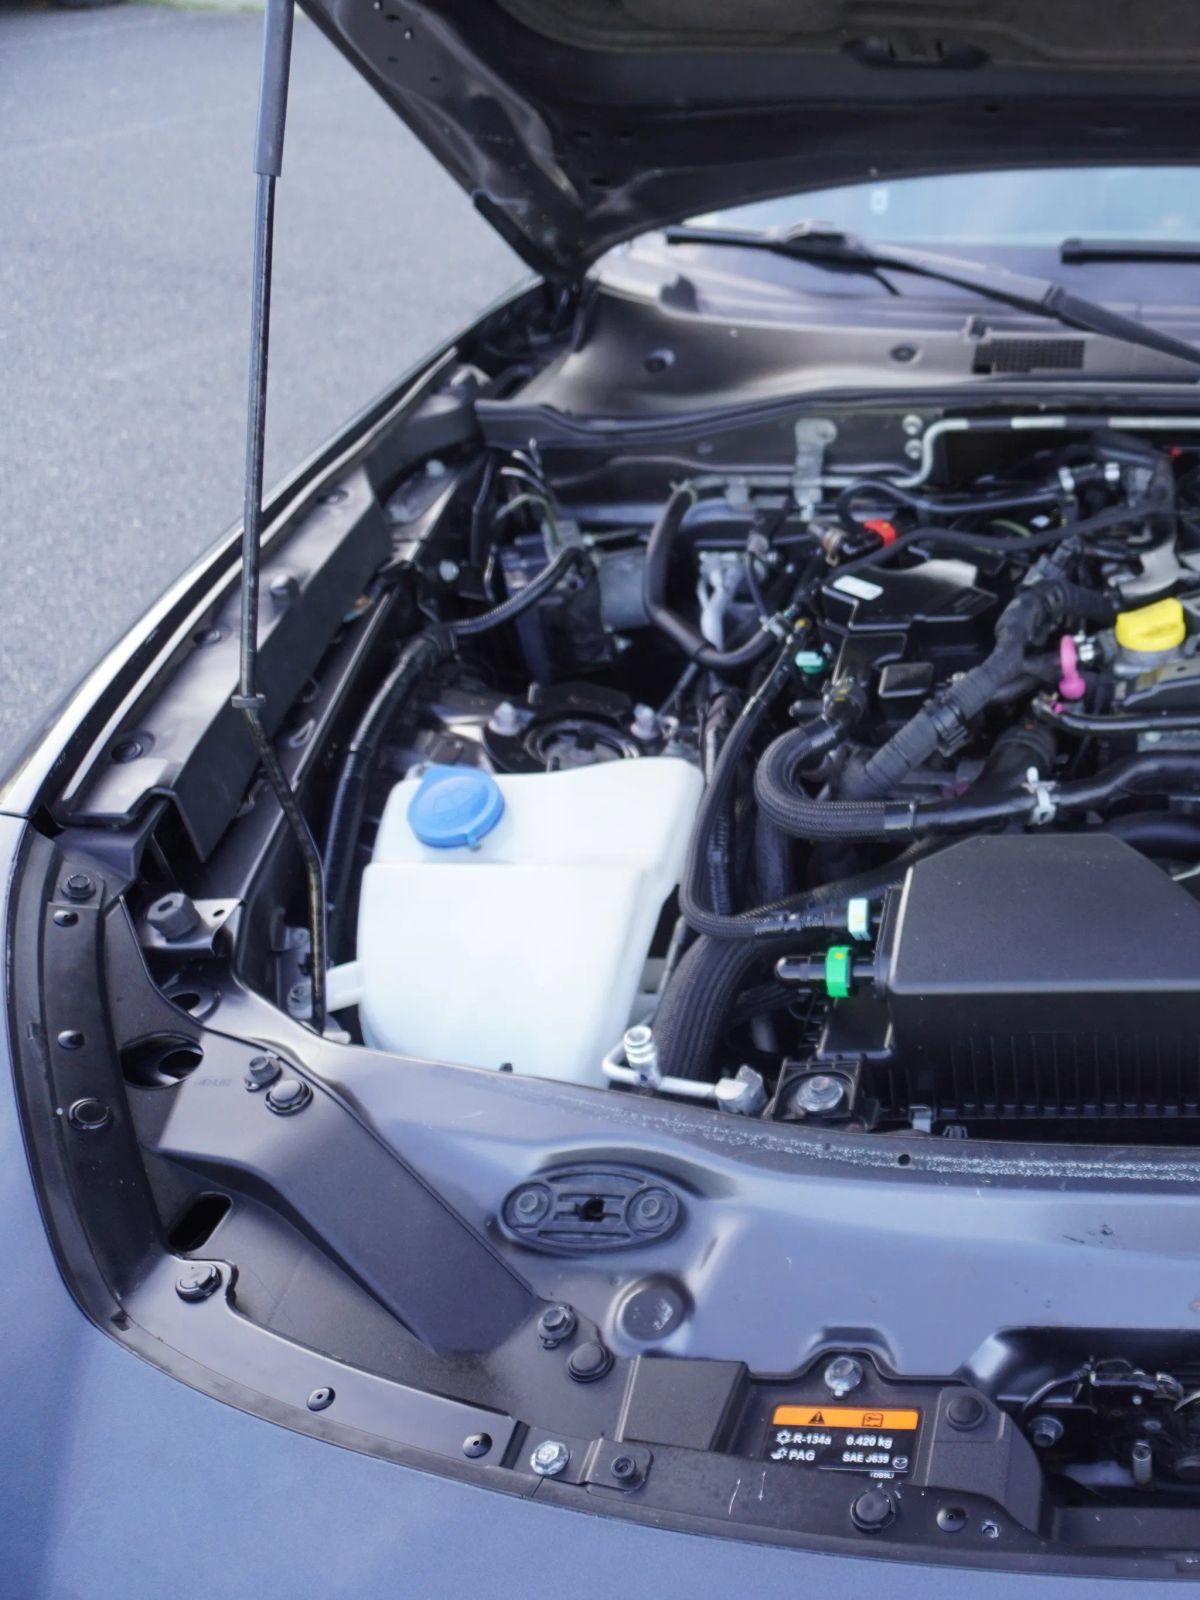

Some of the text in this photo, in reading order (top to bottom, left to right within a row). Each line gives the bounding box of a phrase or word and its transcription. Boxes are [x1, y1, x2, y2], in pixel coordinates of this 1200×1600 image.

[793, 1432, 894, 1449] R-134a 0.420 kg
[788, 1449, 816, 1461] PAG
[842, 1452, 865, 1463] SAE
